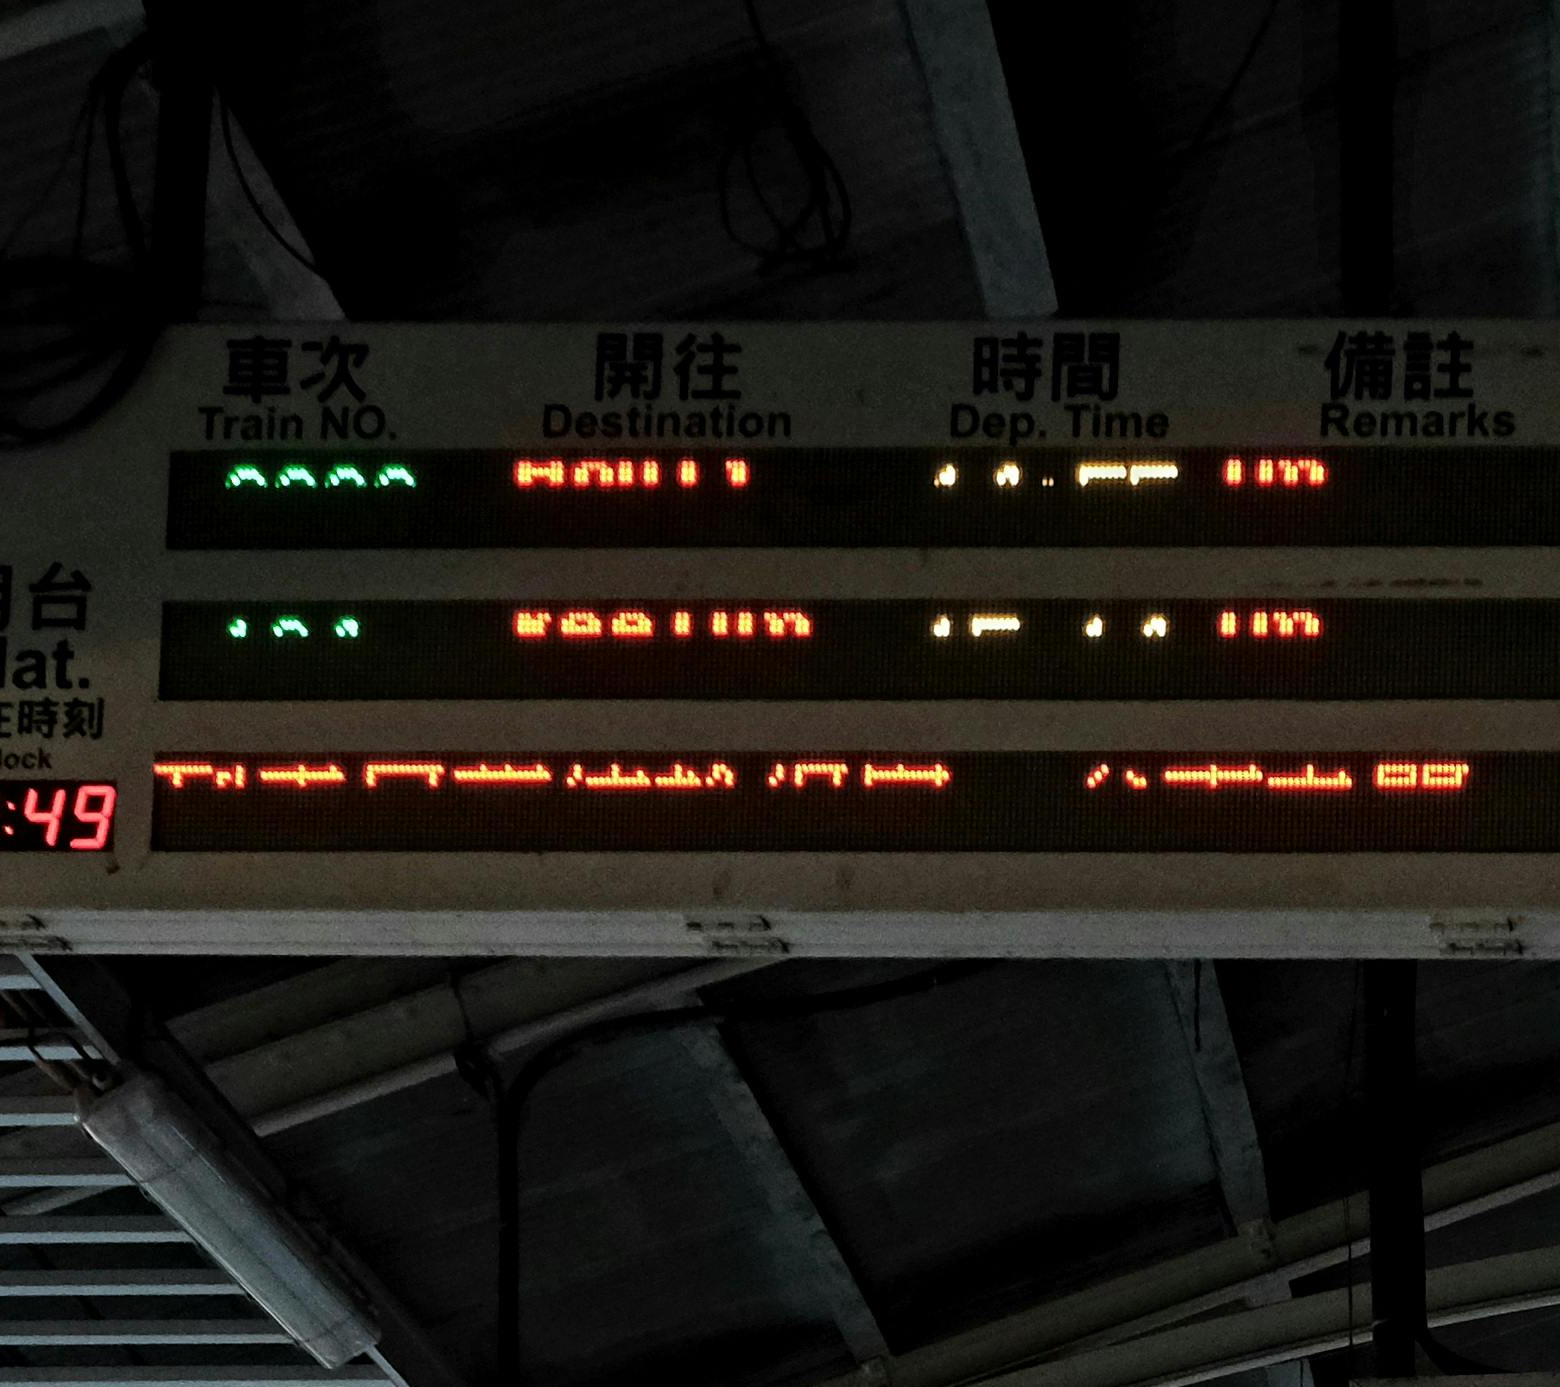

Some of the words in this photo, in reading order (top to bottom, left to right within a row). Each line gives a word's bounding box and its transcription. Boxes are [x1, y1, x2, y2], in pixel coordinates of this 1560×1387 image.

[224, 334, 370, 402] 車次
[595, 332, 743, 402] 開往
[973, 331, 1120, 401] 時間
[1324, 330, 1475, 401] 備註
[199, 407, 305, 441] Train
[320, 407, 397, 441] NO.
[543, 404, 791, 439] Destination
[950, 404, 1047, 444] Dep.
[1065, 403, 1169, 440] Time
[1321, 401, 1516, 439] Remarks
